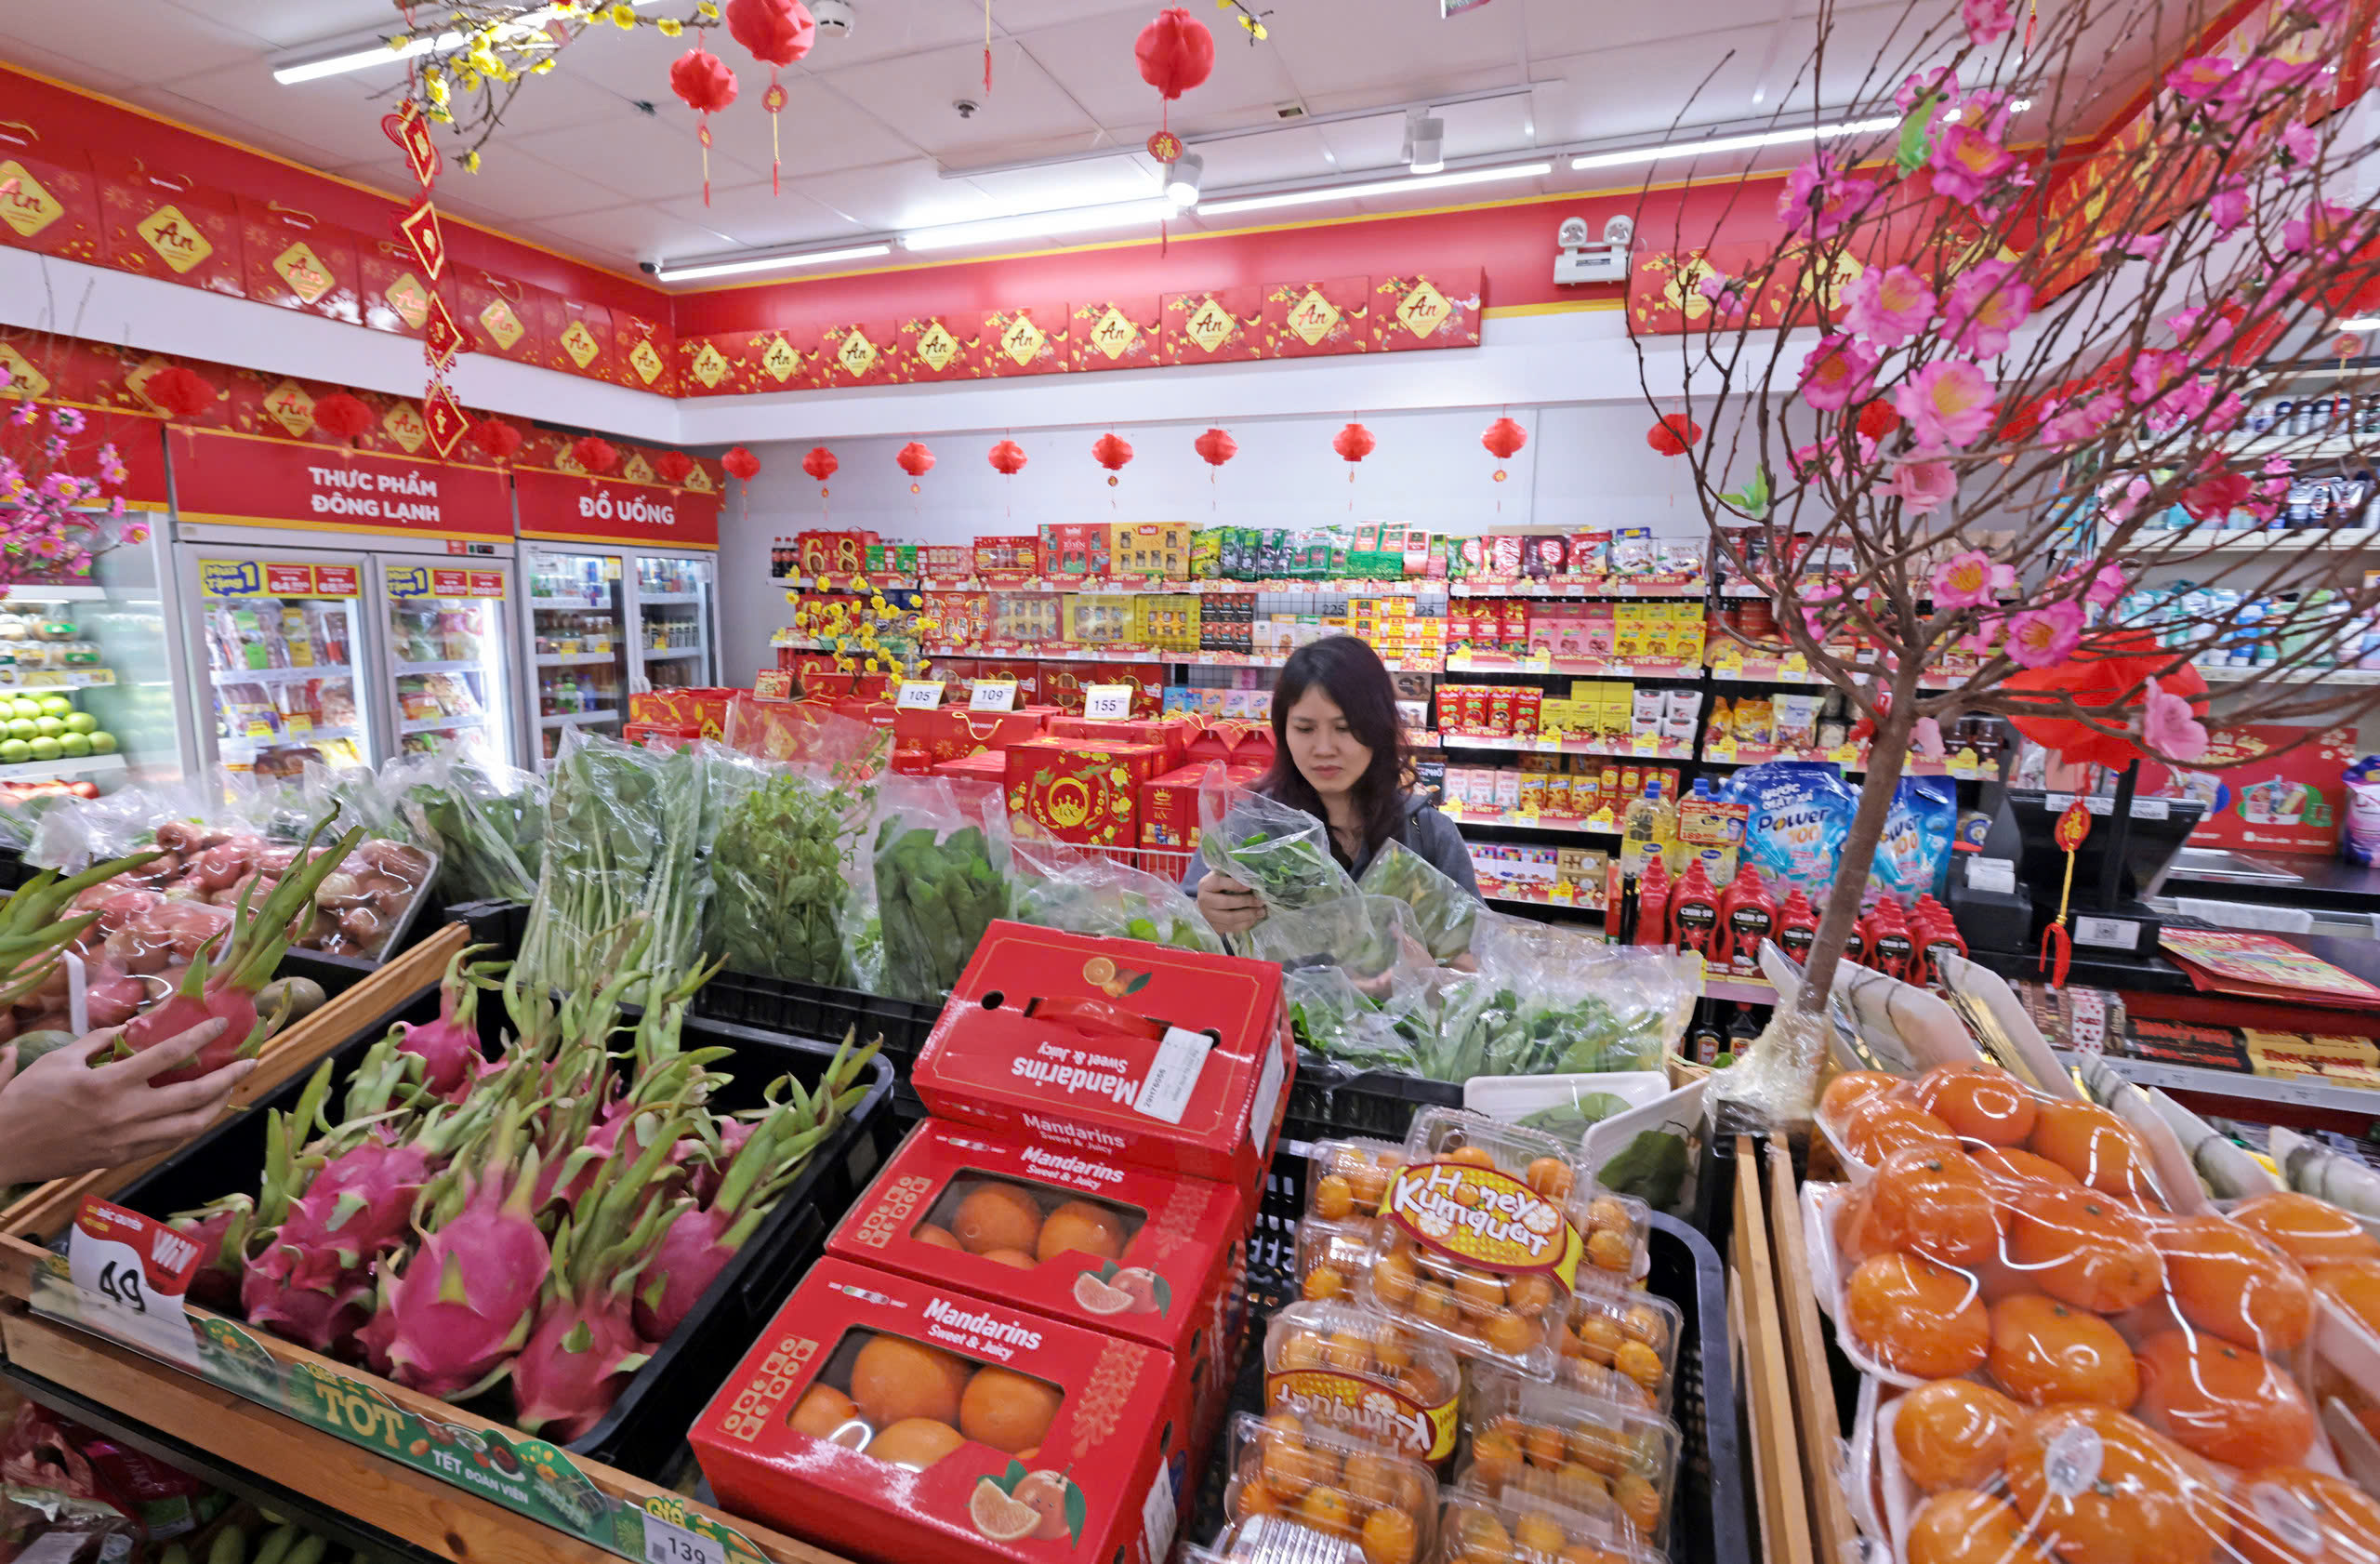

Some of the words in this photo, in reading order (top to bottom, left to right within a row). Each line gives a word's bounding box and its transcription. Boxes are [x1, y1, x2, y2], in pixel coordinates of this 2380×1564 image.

[153, 221, 194, 252] An
[1298, 303, 1328, 326] An
[1407, 295, 1437, 320] An
[1100, 320, 1125, 341] An
[1196, 311, 1223, 334] An
[568, 331, 591, 353] An
[846, 340, 868, 361] An
[925, 335, 948, 355] An
[1010, 327, 1034, 349] An
[771, 347, 790, 365] An
[308, 467, 374, 492] THỰC
[377, 471, 438, 498] PHẨM
[311, 491, 380, 517] ĐÔNG
[383, 499, 442, 524] LẠNH
[578, 490, 612, 520] ĐỒ
[617, 495, 676, 525] UỐNG
[909, 691, 931, 702] 105
[981, 690, 1004, 701] 109
[1093, 699, 1117, 711] 155
[1037, 1040, 1072, 1061] Juicy
[1072, 1050, 1086, 1066] &
[1087, 1052, 1129, 1074] Sweet
[1011, 1056, 1139, 1107] Mandarins
[1022, 1113, 1127, 1149] Mandarins
[1040, 1130, 1072, 1145] Sweet
[1086, 1142, 1113, 1155] Juicy
[1020, 1146, 1126, 1184] Mandarins
[1025, 1163, 1060, 1179] Sweet
[1059, 1171, 1071, 1182] &
[1073, 1174, 1102, 1191] Juicy
[1426, 1163, 1540, 1223] Honey
[1394, 1175, 1550, 1256] Kumquat
[922, 1297, 1043, 1350] Mandarins
[928, 1323, 967, 1345] Sweet
[965, 1335, 980, 1349] &
[980, 1340, 1015, 1362] Juicy
[315, 1377, 405, 1450] TỐT
[431, 1450, 463, 1475] TẾT
[465, 1467, 500, 1491] ĐOÀN
[500, 1479, 530, 1504] VIÊN
[668, 1536, 707, 1564] 139
